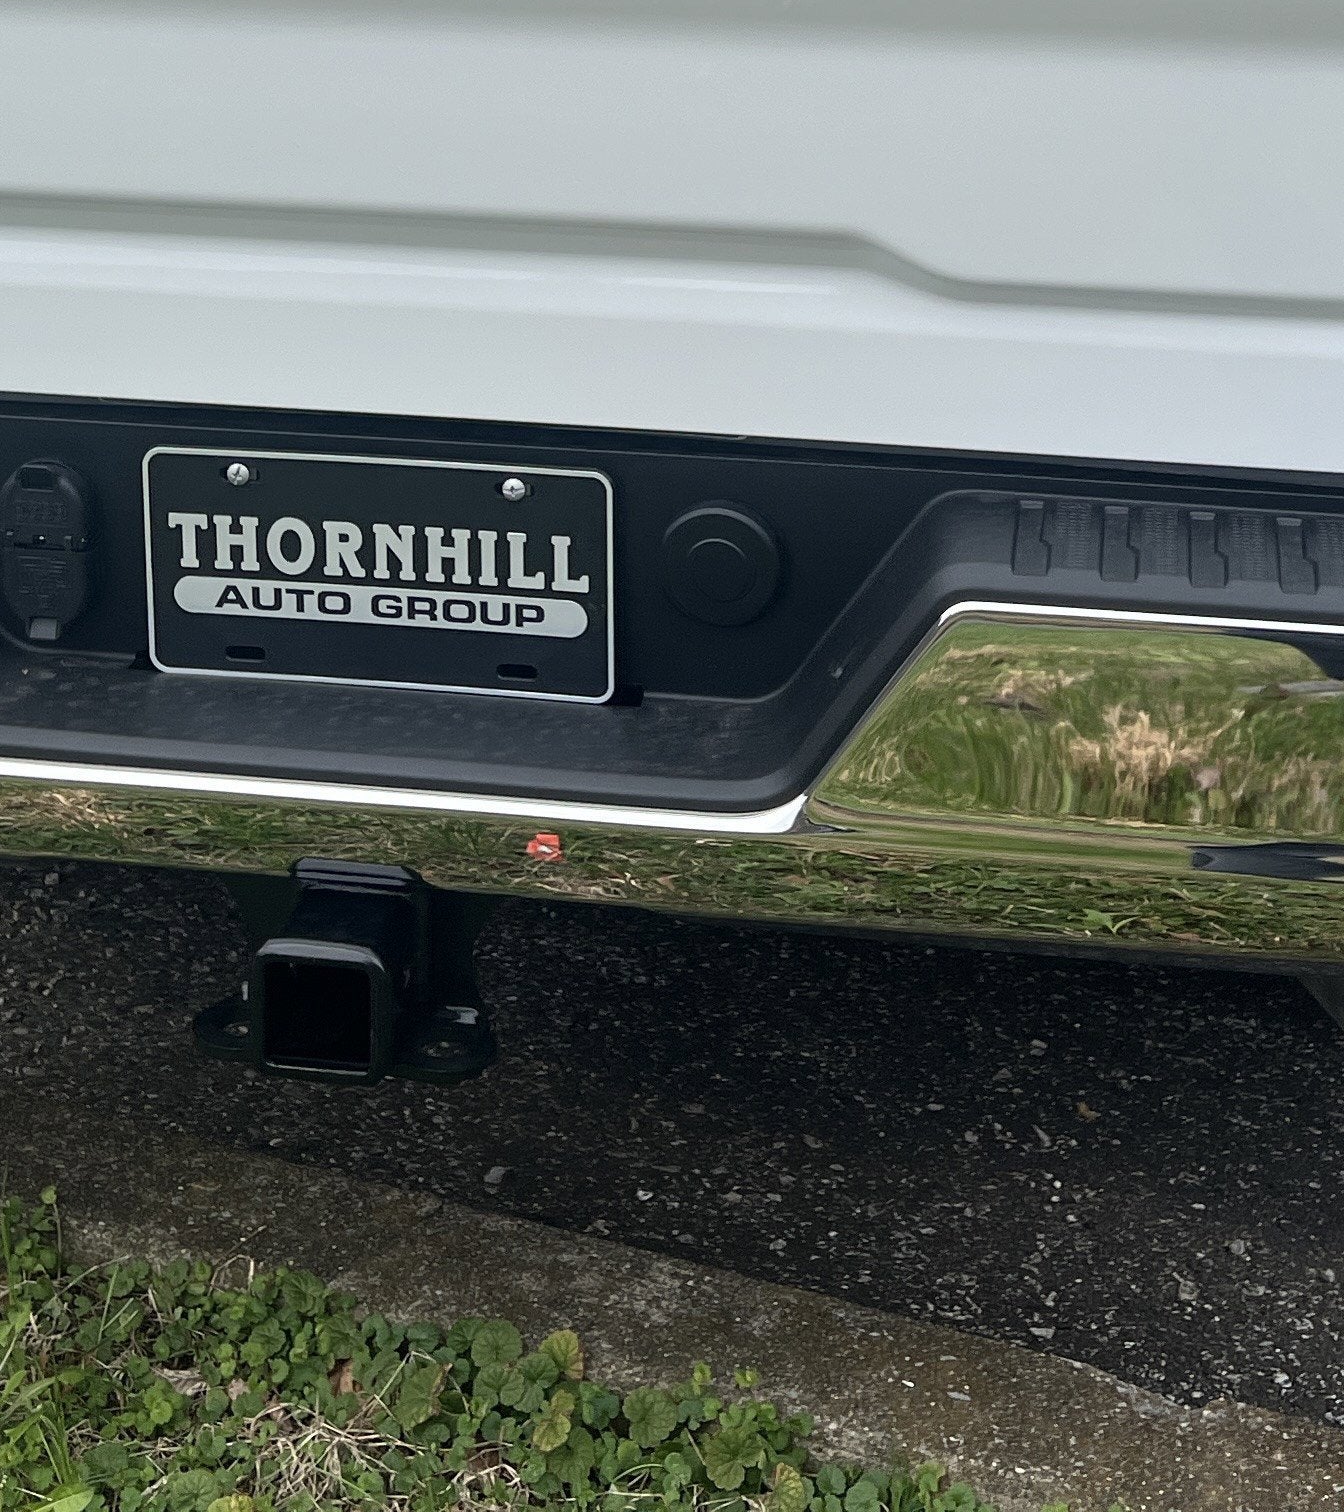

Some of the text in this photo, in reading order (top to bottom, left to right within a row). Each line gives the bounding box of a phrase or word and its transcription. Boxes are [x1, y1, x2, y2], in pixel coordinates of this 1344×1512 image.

[167, 512, 590, 594] THORNHILL
[215, 584, 545, 629] AUTO GROUP
